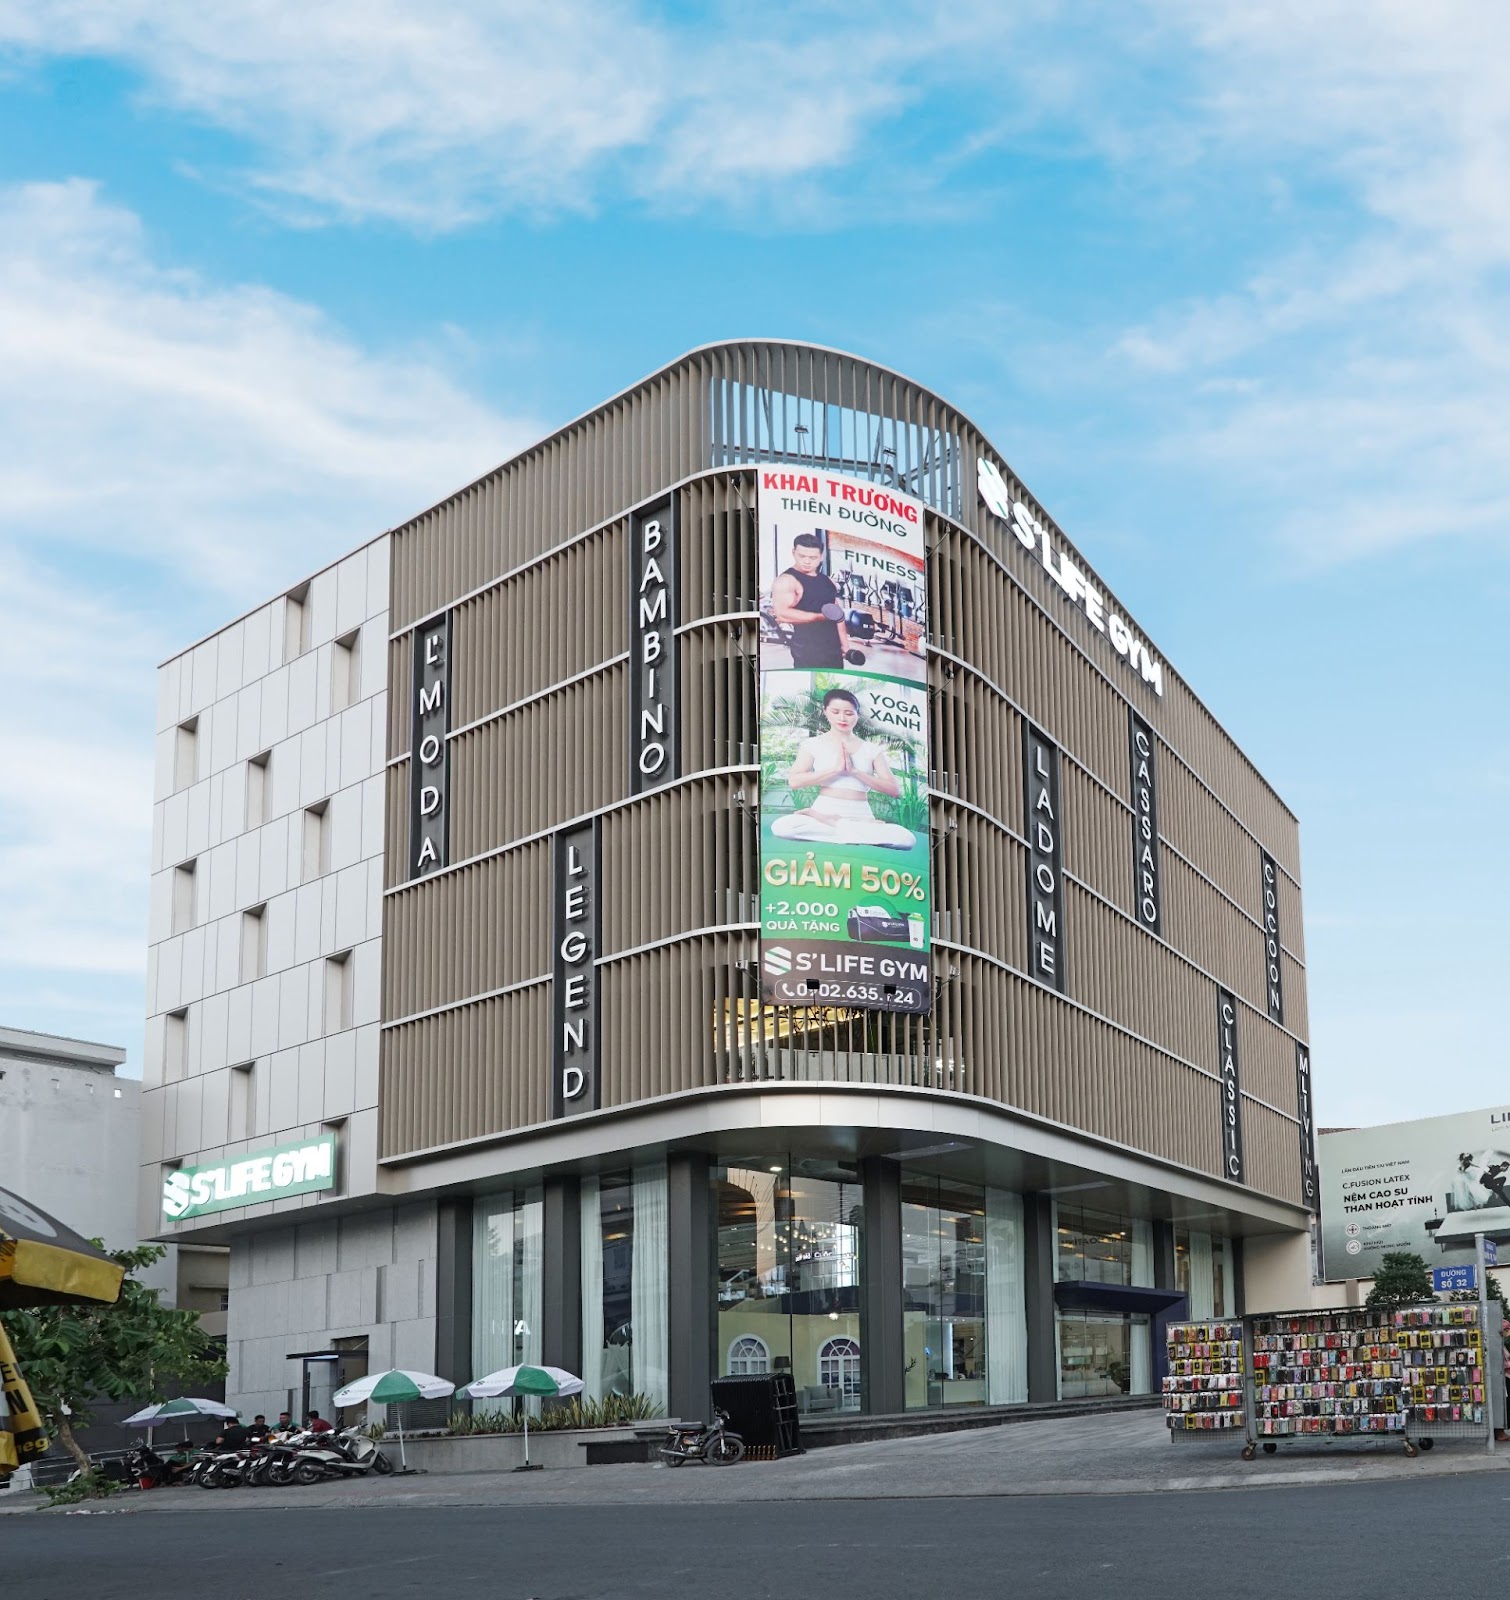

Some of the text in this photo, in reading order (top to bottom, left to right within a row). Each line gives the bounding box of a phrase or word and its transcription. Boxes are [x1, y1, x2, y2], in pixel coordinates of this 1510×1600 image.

[763, 473, 918, 525] KHAI TRƯƠNG
[781, 498, 907, 538] THIÊN ĐƯỜNG
[844, 549, 918, 582] FITNESS
[639, 520, 667, 775] BAMBINO
[1108, 613, 1162, 697] GYM
[869, 692, 921, 718] YOGA
[870, 707, 921, 732] XANH
[418, 634, 441, 867] L'MODA
[1135, 731, 1157, 923] CASSARO
[764, 852, 925, 901] GIẢM 50%
[1036, 745, 1057, 975] LADOME
[765, 901, 839, 918] +2.000
[766, 918, 840, 934] QUÀ TẶNG
[1264, 863, 1280, 1012] COCOON
[560, 845, 587, 1100] LEGEND
[880, 959, 928, 983] GYM
[1222, 1003, 1240, 1176] CLASSIC
[272, 1142, 332, 1187] GYM
[1342, 1174, 1410, 1190] C.FUSION LATEX
[1343, 1187, 1408, 1203] NỆM CAO SU
[1344, 1195, 1433, 1214] THAN HOẠT TÍNH
[1440, 1268, 1467, 1278] ĐƯỜNG
[1440, 1276, 1467, 1289] SỐ 32
